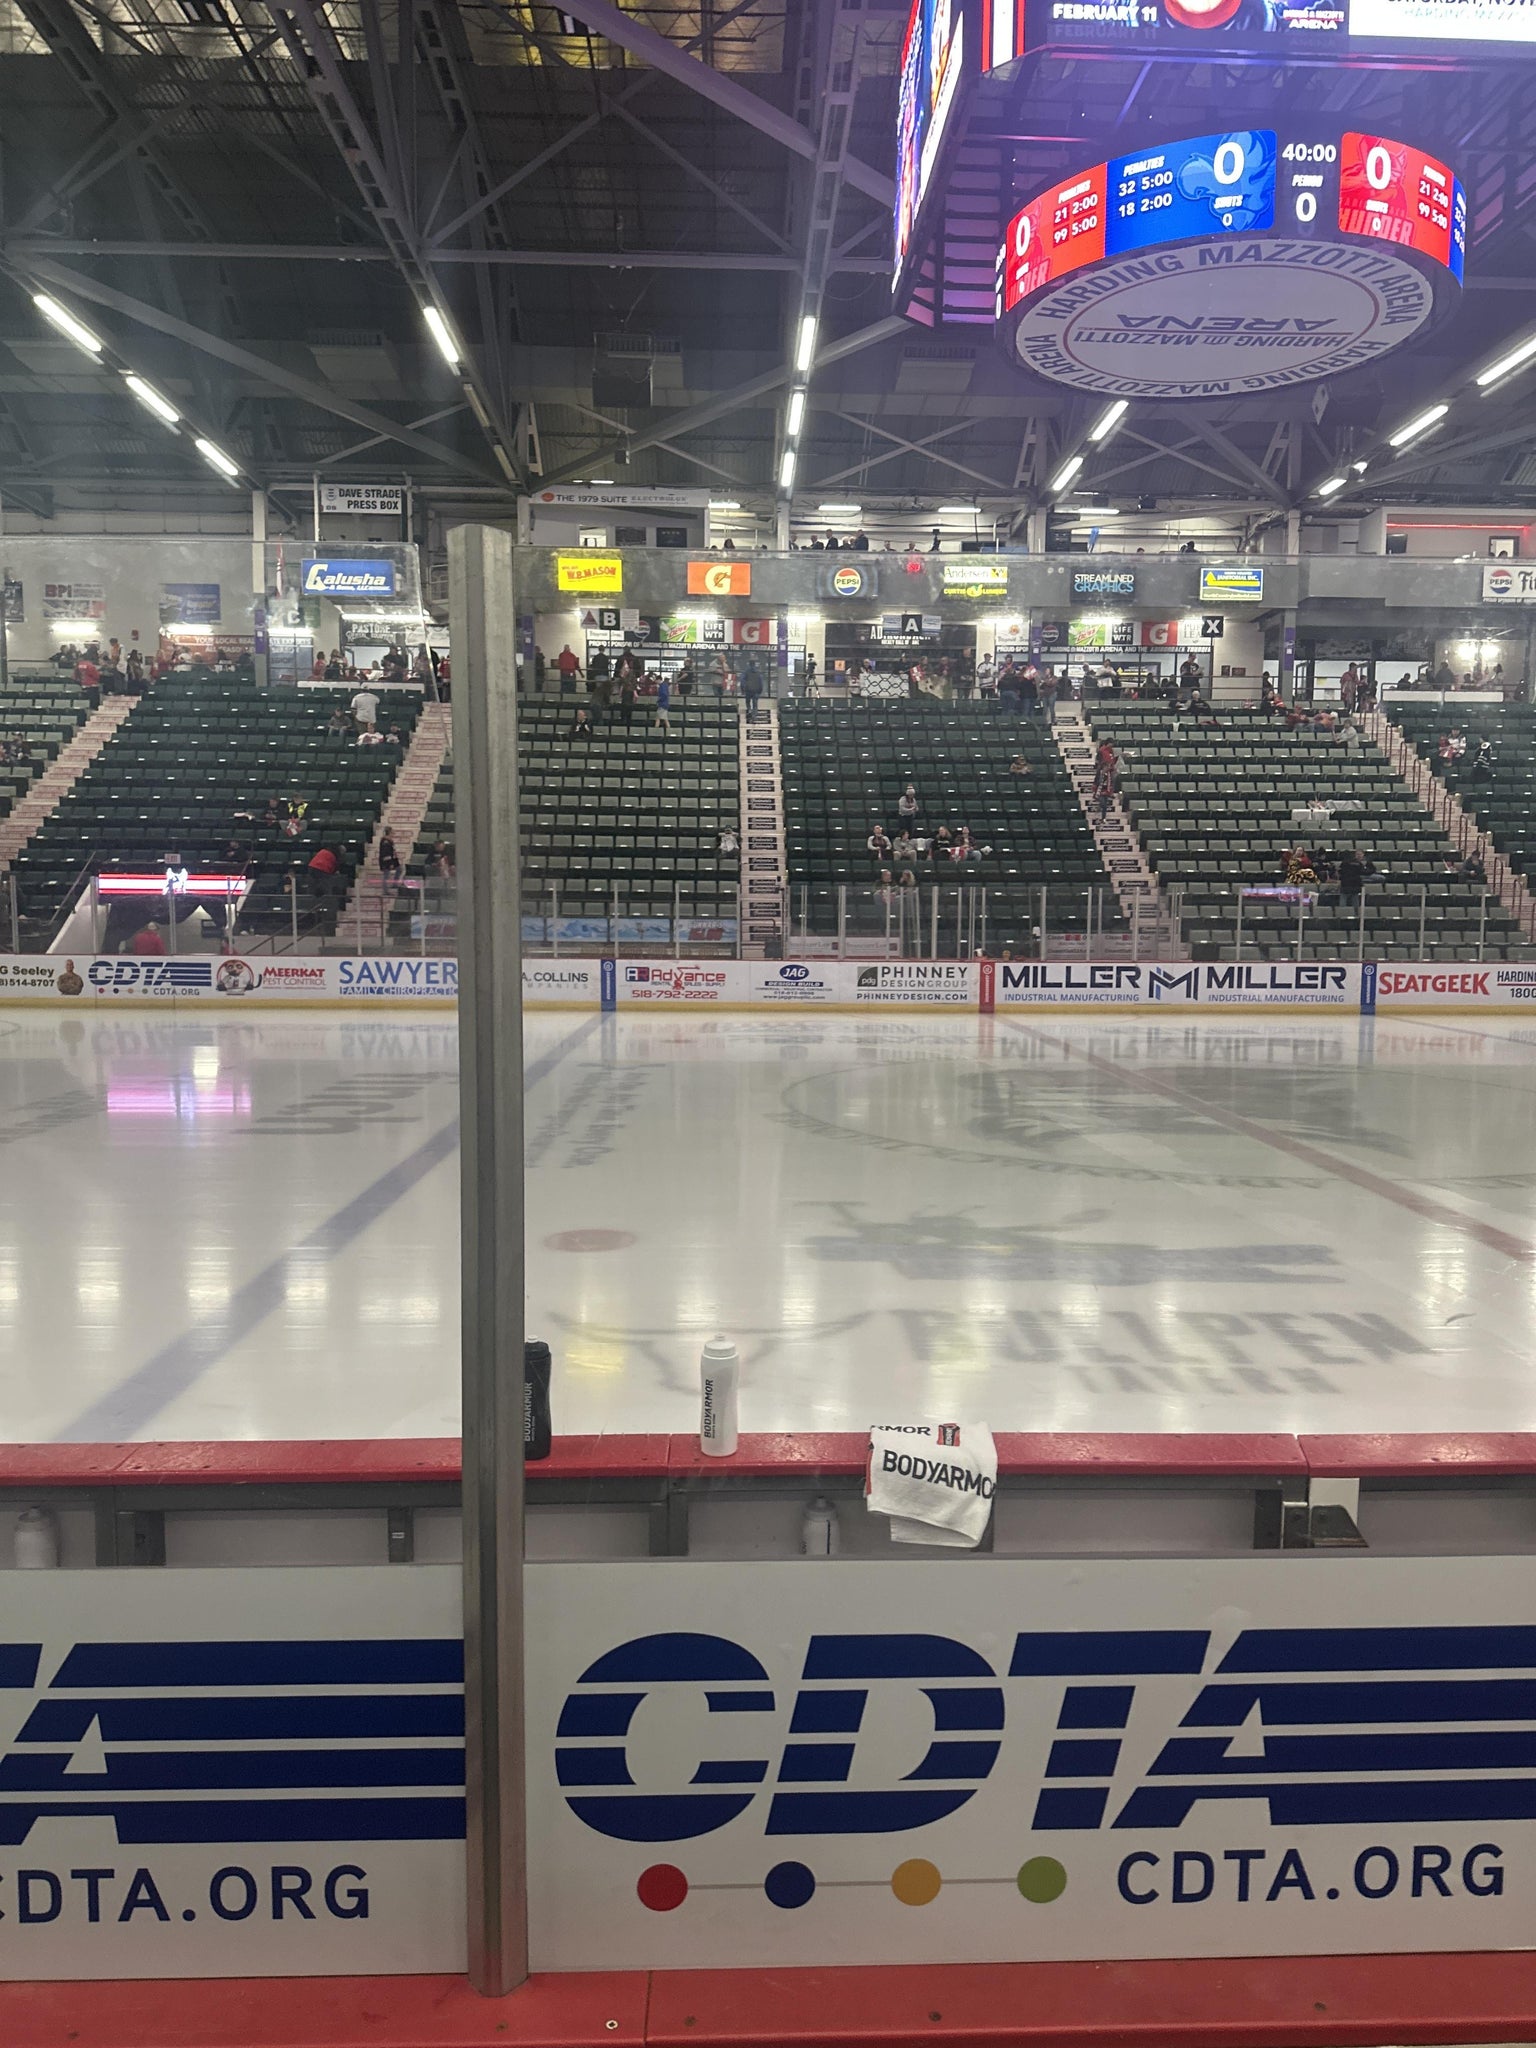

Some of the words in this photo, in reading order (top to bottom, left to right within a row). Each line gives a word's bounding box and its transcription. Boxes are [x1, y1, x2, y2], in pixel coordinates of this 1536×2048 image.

[1053, 3, 1140, 21] FEBRUARY
[1142, 6, 1157, 22] 11
[1282, 143, 1337, 163] 40:00
[1214, 141, 1245, 185] 0
[1366, 146, 1392, 190] 0
[1118, 181, 1136, 198] 32
[1141, 170, 1174, 191] 5:00
[1054, 206, 1069, 224] 21
[1071, 193, 1099, 214] 2:00
[1118, 201, 1136, 218] 18
[1140, 193, 1173, 213] 2:00
[1295, 192, 1317, 222] 0
[1222, 213, 1233, 227] 0
[1371, 217, 1381, 232] 0
[1015, 215, 1031, 247] 0
[1053, 228, 1068, 244] 99
[1071, 215, 1098, 236] 5:00
[1036, 254, 1185, 320] HARDING
[1198, 243, 1395, 286] MAZZOTTI
[1371, 273, 1428, 327] ARENA
[1117, 313, 1338, 333] ARENA
[1073, 330, 1199, 346] MAZZOTTI
[1234, 334, 1347, 348] HARDING
[1024, 333, 1085, 376] ARENA
[1243, 339, 1390, 389] HARDING
[1071, 371, 1230, 395] MAZZOTTI
[338, 488, 362, 499] DAVE
[364, 488, 400, 499] STRADE
[556, 494, 575, 502] THE
[578, 495, 599, 503] 1979
[600, 495, 628, 504] SUITE
[347, 500, 378, 510] PRESS
[380, 501, 399, 510] BOX
[305, 563, 387, 591] Galusha
[705, 565, 732, 594] G
[836, 578, 860, 586] PEPSI
[1074, 573, 1135, 583] STREAMLINED
[1517, 570, 1536, 593] Fi
[1074, 582, 1135, 593] GRAPHICS
[603, 611, 617, 627] B
[704, 622, 724, 630] LIFE
[904, 618, 919, 633] A
[1206, 619, 1220, 634] X
[704, 631, 724, 639] WTR
[741, 621, 761, 643] G
[1113, 625, 1132, 633] LIFE
[1150, 623, 1169, 645] G
[12, 966, 55, 978] Seeley
[88, 960, 211, 986] CDTA
[263, 966, 326, 978] MEERKAT
[338, 960, 458, 985] SAWYER
[533, 972, 589, 983] COLLINS
[651, 966, 727, 984] Advance
[781, 967, 807, 977] JAG
[881, 966, 968, 979] PHINNEY
[1002, 965, 1142, 989] MILLER
[1206, 965, 1347, 990] MILLER
[262, 977, 282, 986] PEST
[283, 978, 327, 986] CONTROL
[861, 977, 877, 986] pdg
[881, 979, 968, 988] DESIGNGROUP
[1378, 972, 1491, 996] SEATGEEK
[153, 988, 200, 996] CDTA.ORG
[340, 986, 379, 995] FAMILY
[383, 986, 458, 995] CHIROPRACTIC
[631, 990, 719, 1000] 518-792-2222
[856, 993, 968, 1001] PHINNEYDESIGN.COM
[1004, 993, 1058, 1002] INDUSTRIAL
[1060, 993, 1140, 1002] MANUFACTURING
[1208, 994, 1263, 1003] INDUSTRIAL
[1264, 994, 1345, 1003] MANUFACTURING
[703, 1378, 714, 1439] BODYARMOR
[871, 1424, 932, 1436] MOR
[555, 1624, 1536, 1843] CDTA
[1116, 1842, 1504, 1906] CDTA.ORG
[0, 1863, 370, 1925] DTA.ORG
